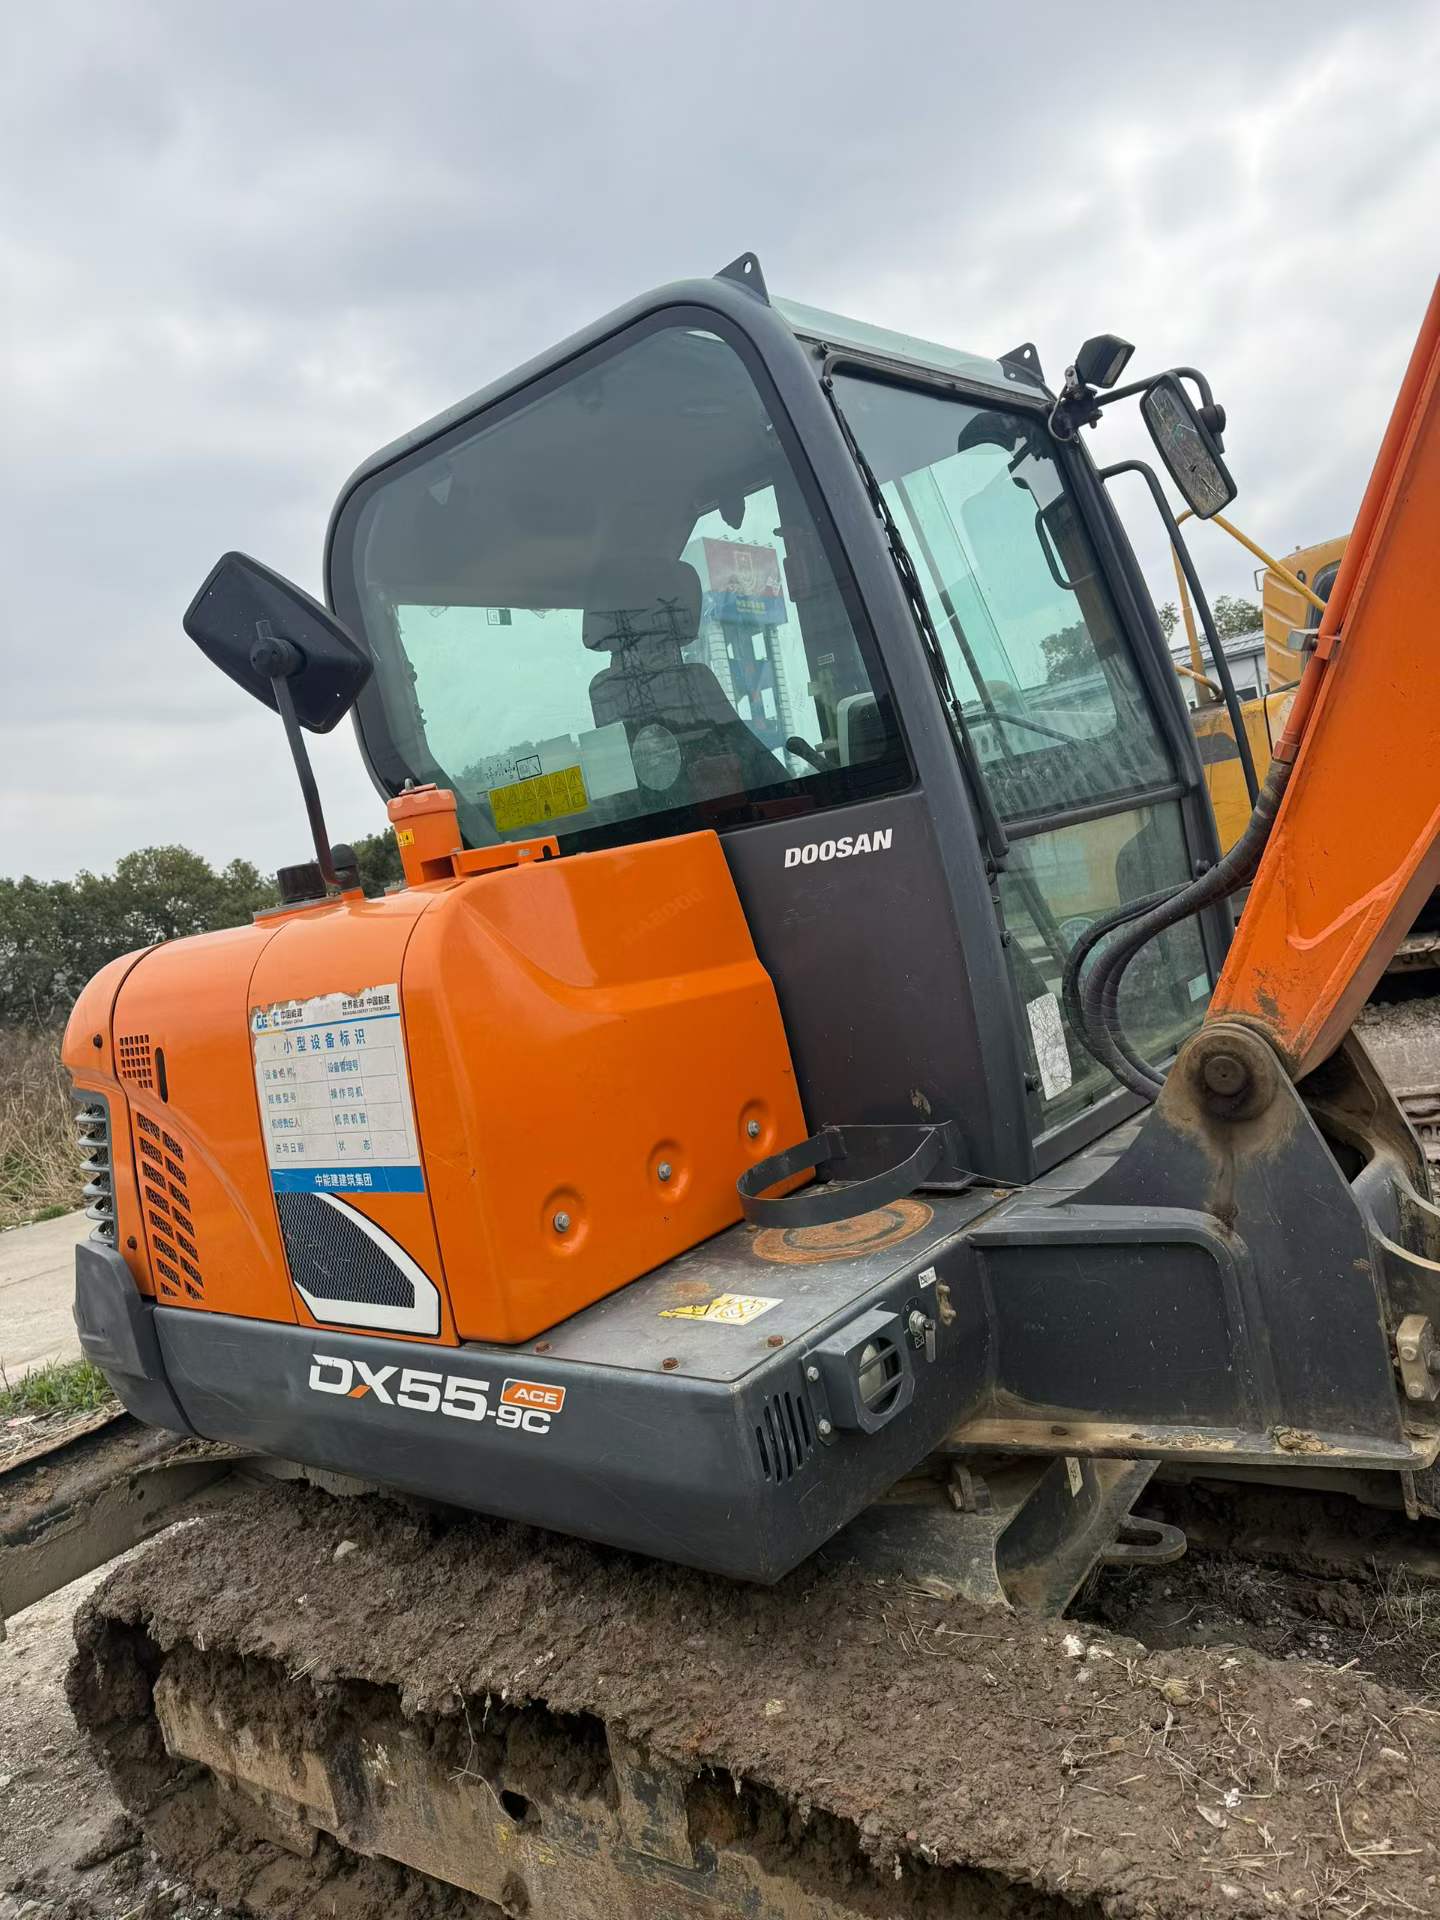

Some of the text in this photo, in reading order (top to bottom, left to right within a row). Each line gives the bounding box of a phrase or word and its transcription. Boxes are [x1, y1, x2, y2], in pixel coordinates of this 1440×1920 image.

[784, 828, 893, 868] DOOSAN
[283, 1028, 366, 1054] 小型设备标识
[314, 1173, 372, 1187] 中能建建筑集团
[514, 1388, 558, 1405] ACE
